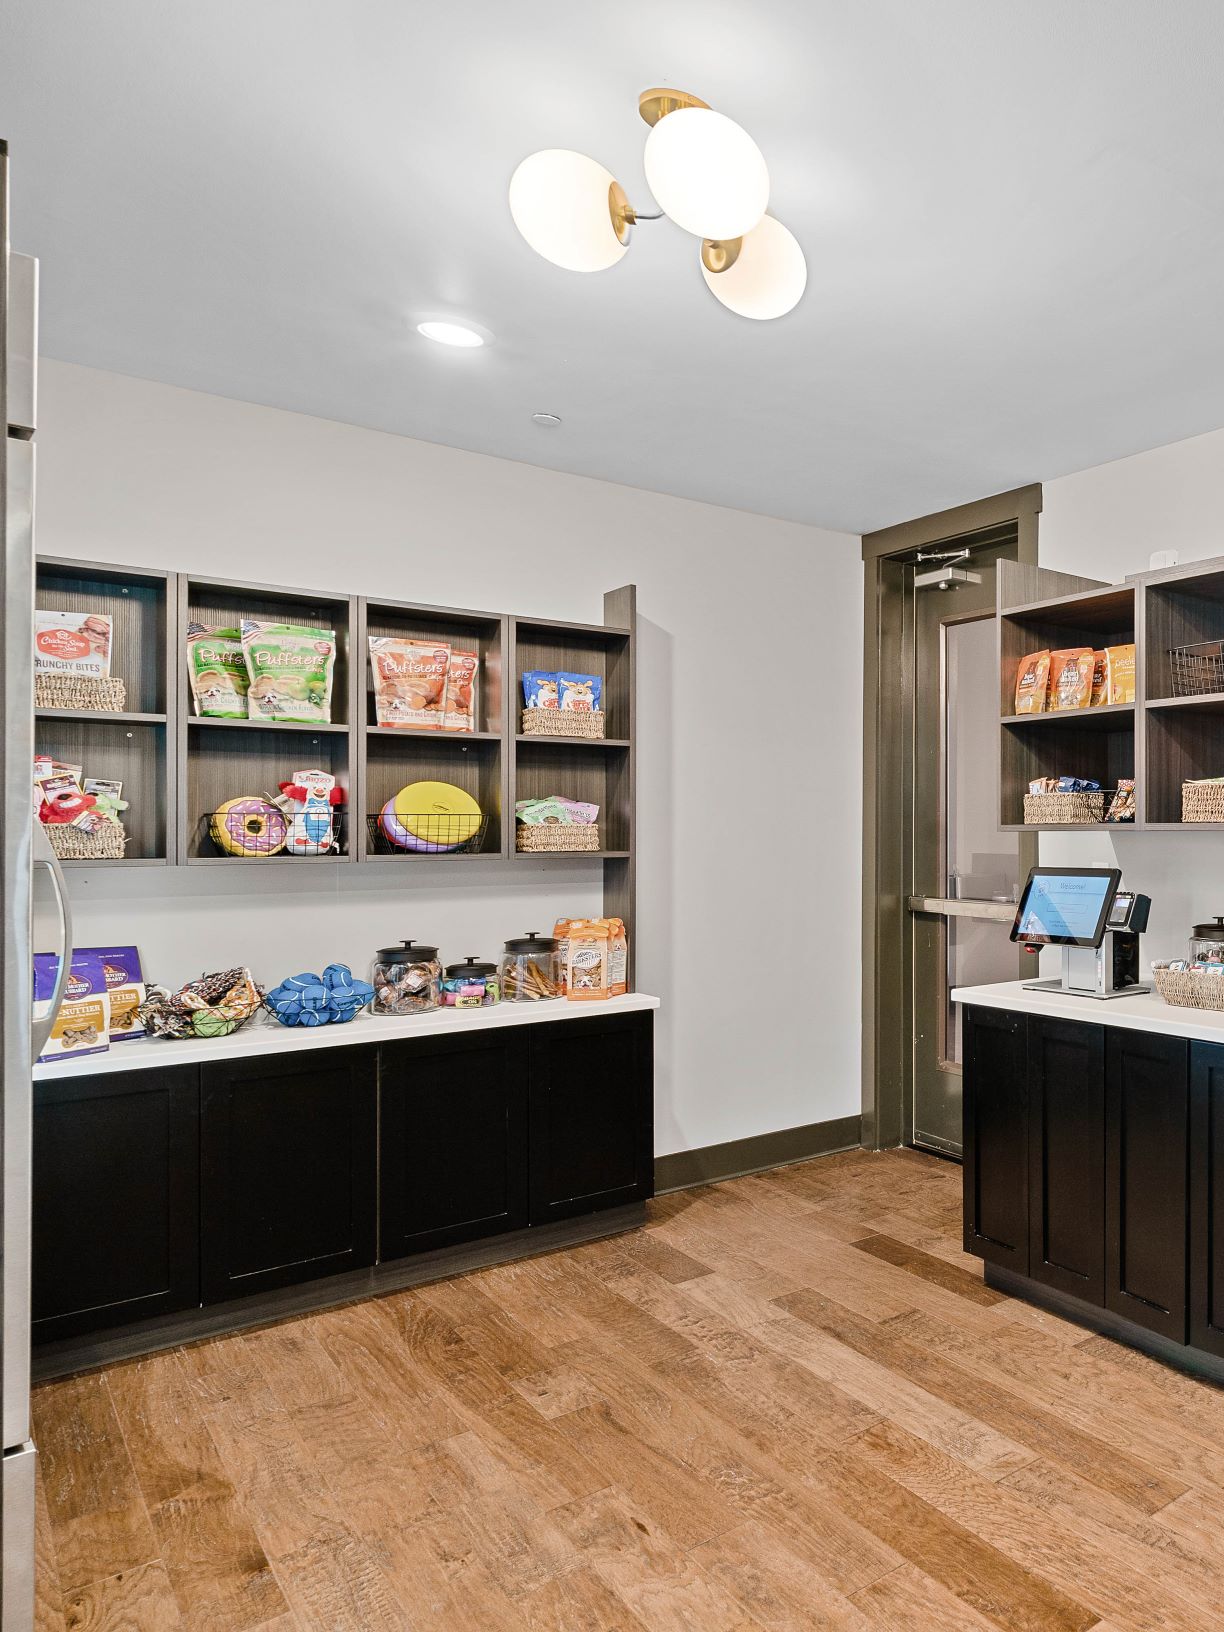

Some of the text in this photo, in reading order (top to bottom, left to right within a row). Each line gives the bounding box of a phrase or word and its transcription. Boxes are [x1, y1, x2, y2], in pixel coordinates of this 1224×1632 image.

[198, 648, 247, 665] Puffst
[254, 651, 325, 666] Puffsters
[36, 660, 100, 672] RUNCHY BITES
[383, 660, 443, 675] Puffsters
[59, 1004, 101, 1016] -NUTTIER
